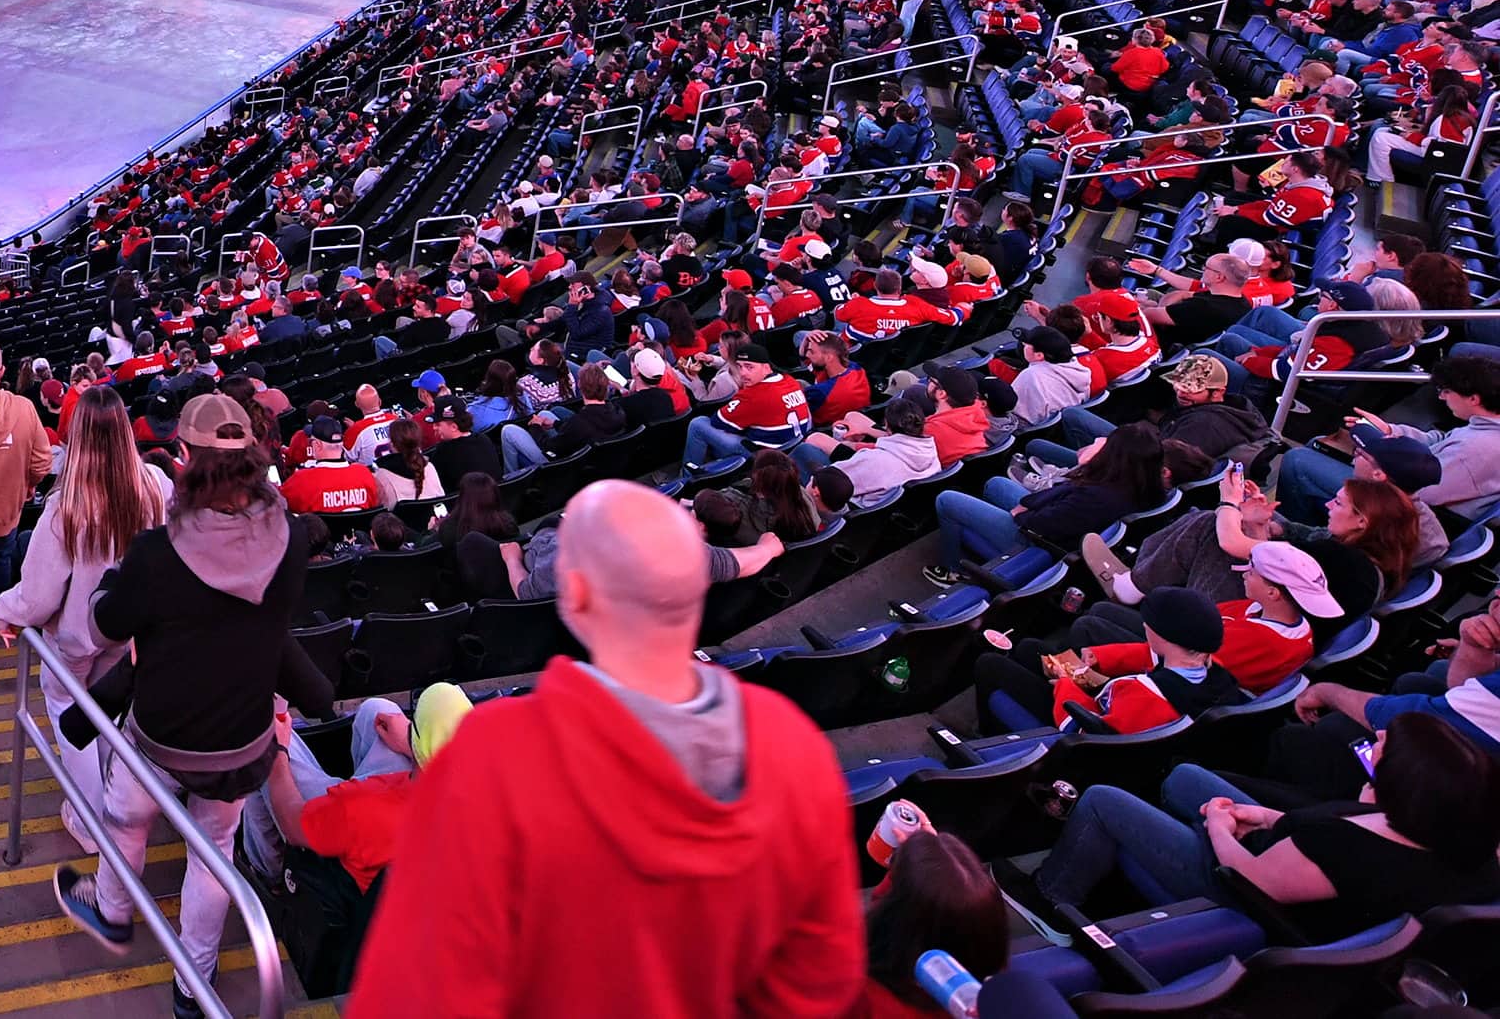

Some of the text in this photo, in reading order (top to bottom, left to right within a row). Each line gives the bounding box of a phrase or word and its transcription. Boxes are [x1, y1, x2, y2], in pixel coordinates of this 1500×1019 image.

[1274, 199, 1297, 219] 93
[727, 399, 741, 413] 4
[781, 389, 807, 410] SUZU
[373, 425, 389, 441] PRI
[322, 488, 368, 508] RICHARD
